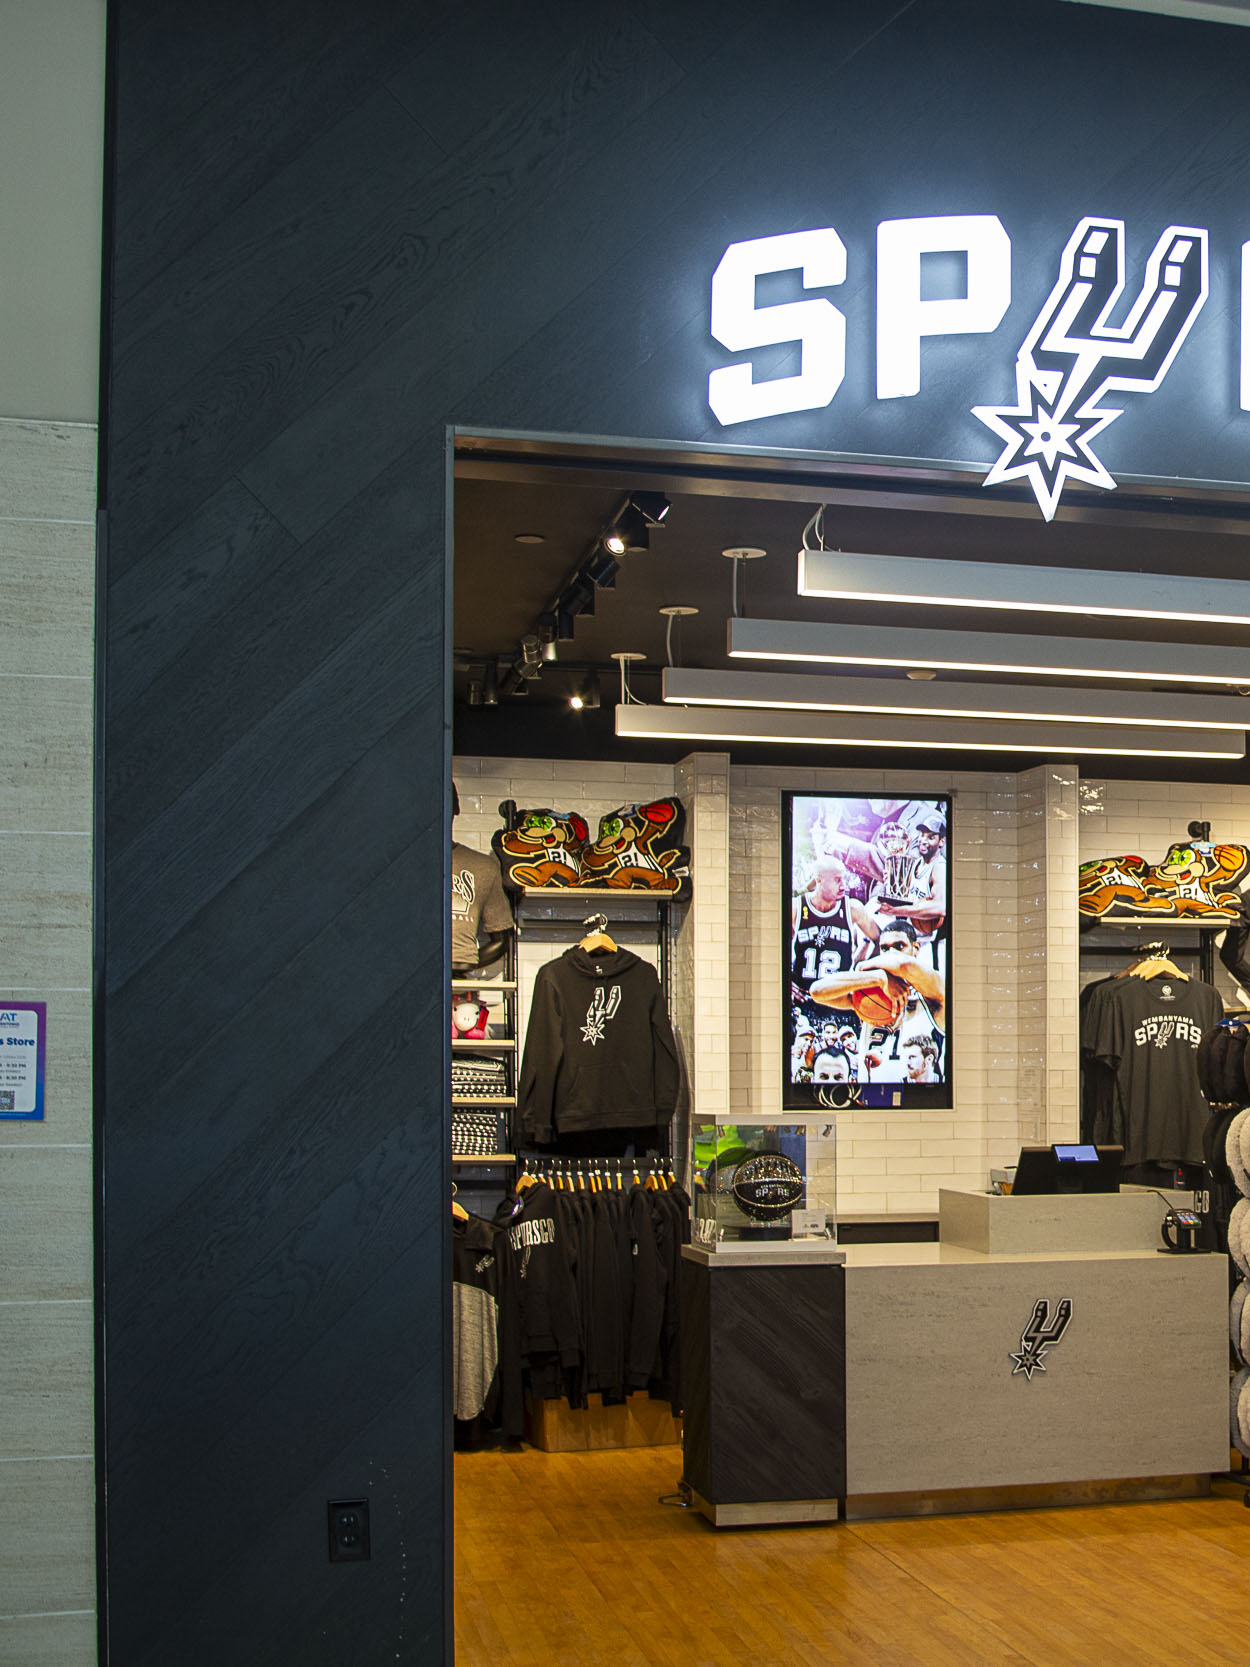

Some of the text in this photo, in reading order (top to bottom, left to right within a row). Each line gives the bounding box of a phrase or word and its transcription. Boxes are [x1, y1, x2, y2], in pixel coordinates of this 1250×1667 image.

[802, 947, 841, 980] 12
[6, 1037, 35, 1046] Store
[1134, 1021, 1202, 1049] SPURS
[755, 1187, 790, 1198] SPRS
